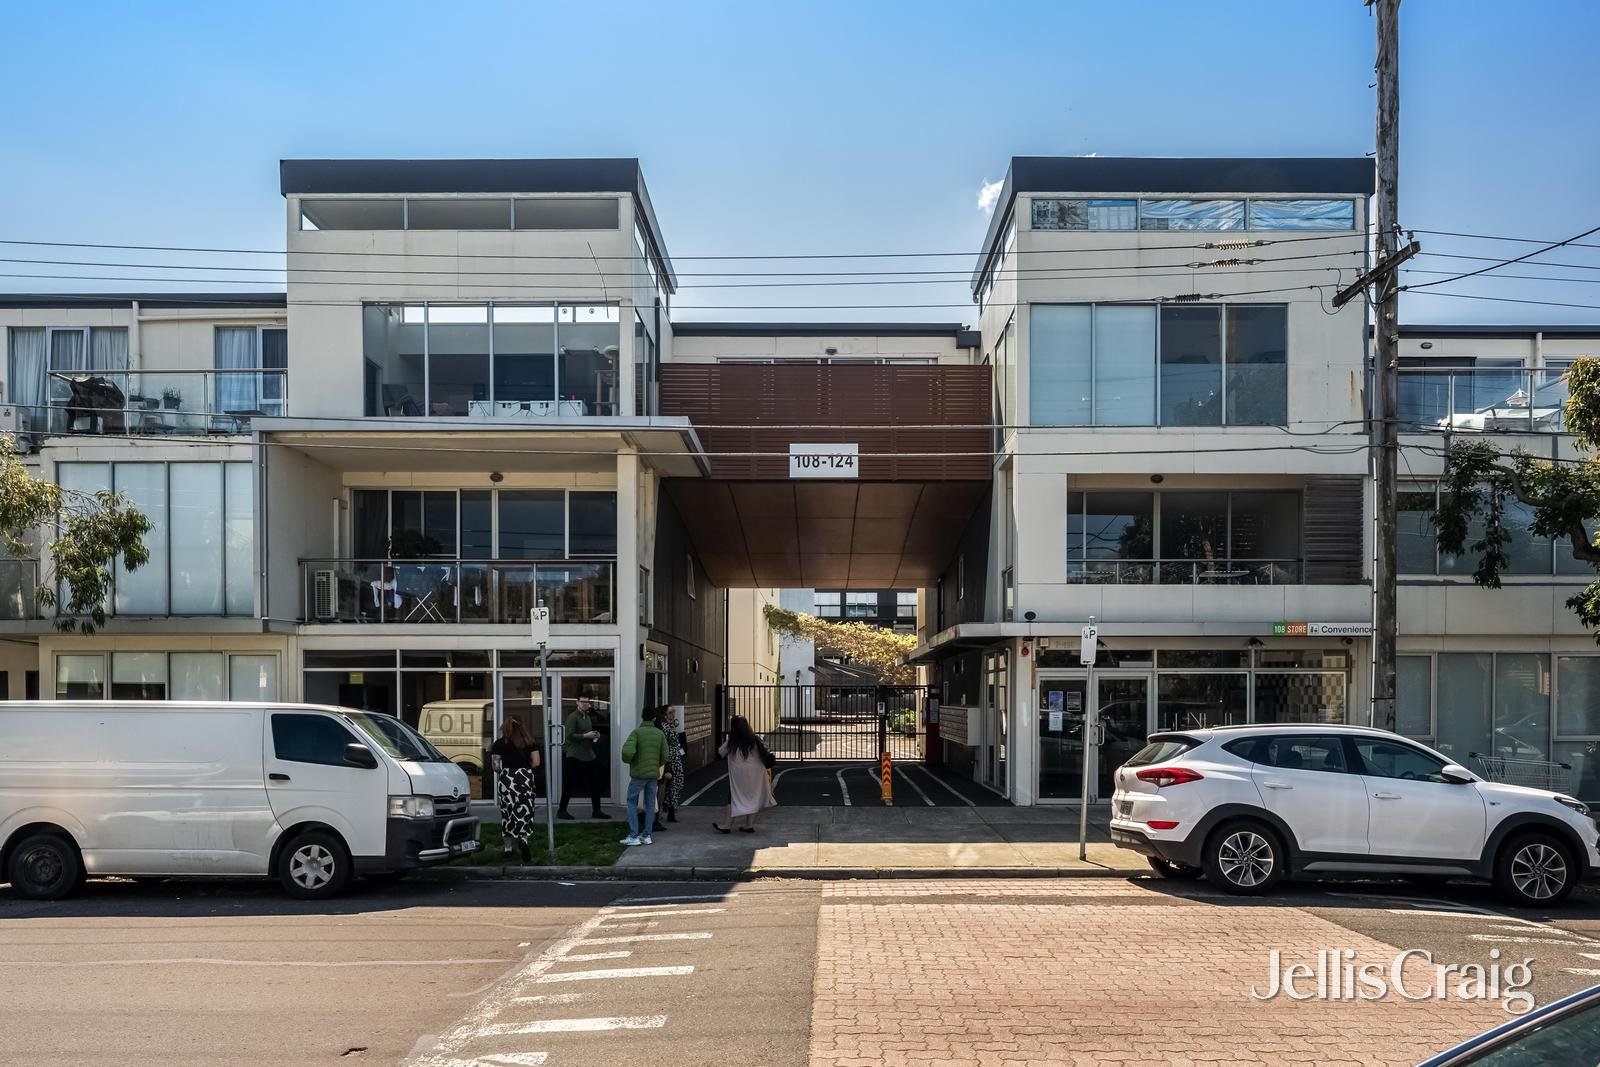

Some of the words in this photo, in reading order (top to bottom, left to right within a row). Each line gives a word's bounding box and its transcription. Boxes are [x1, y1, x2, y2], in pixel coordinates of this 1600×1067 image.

[795, 452, 854, 468] 108-124
[1274, 625, 1286, 633] 108
[1287, 625, 1307, 633] STORE
[423, 713, 475, 733] JOH
